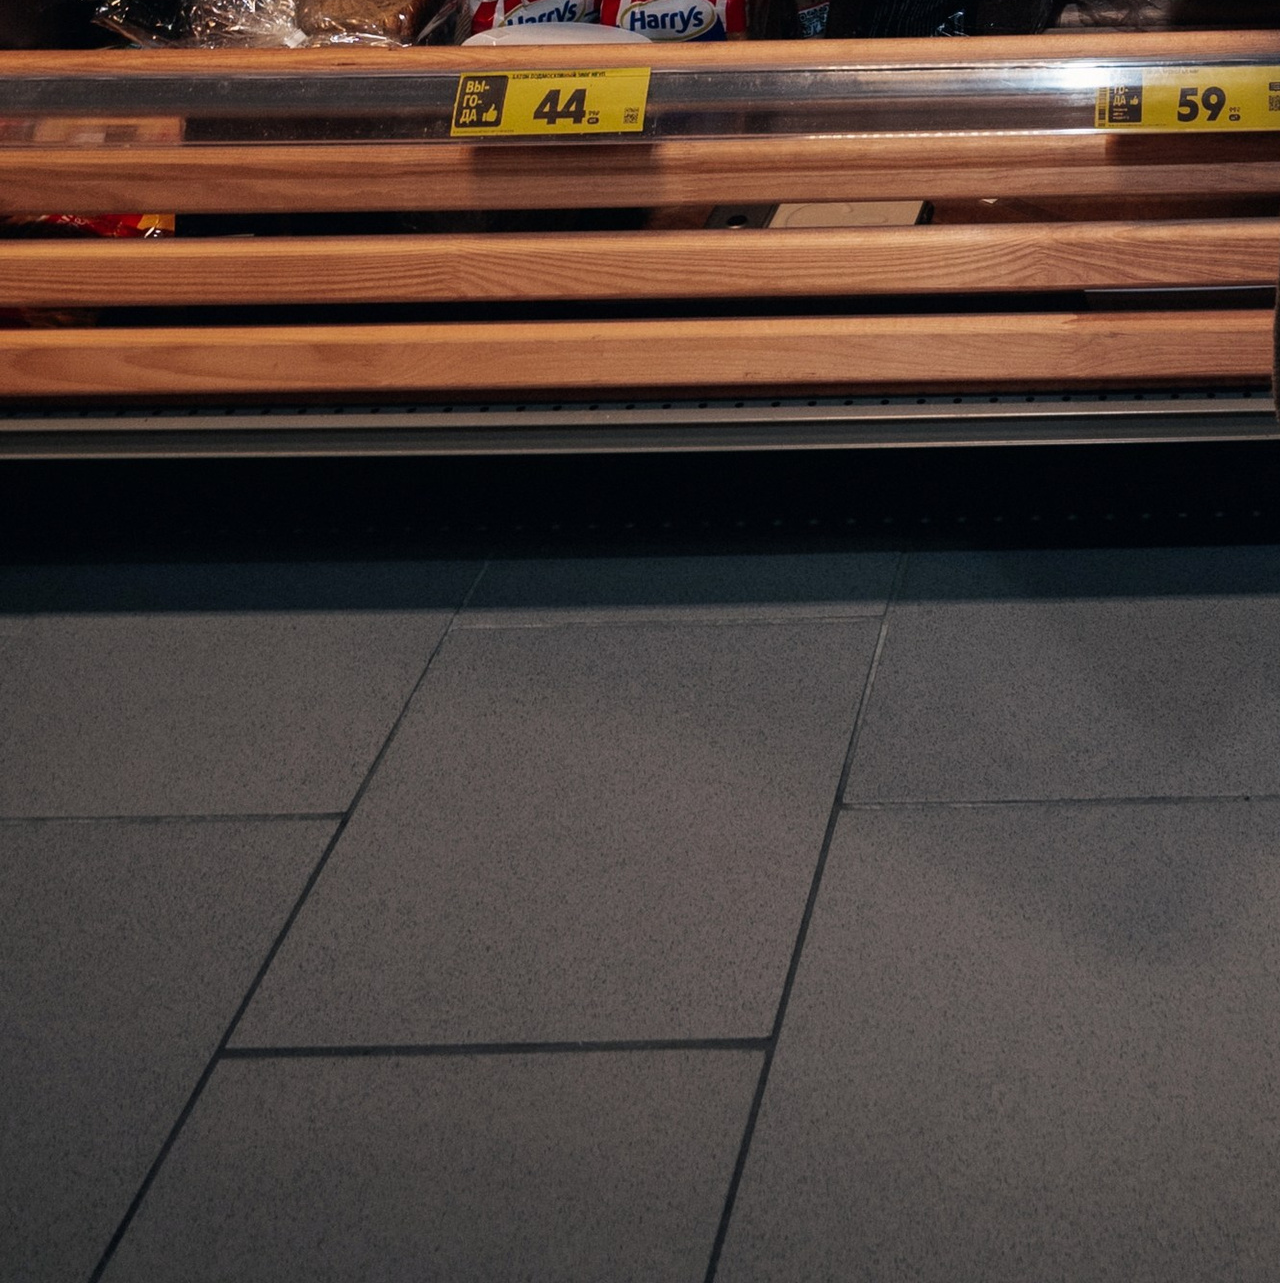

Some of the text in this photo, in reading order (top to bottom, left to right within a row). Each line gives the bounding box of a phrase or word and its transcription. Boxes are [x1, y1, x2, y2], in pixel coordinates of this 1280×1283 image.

[466, 81, 490, 93] ВЫ-
[463, 95, 482, 107] ГО-
[533, 88, 587, 125] 44
[1177, 87, 1226, 122] 59
[460, 109, 477, 124] ДА
